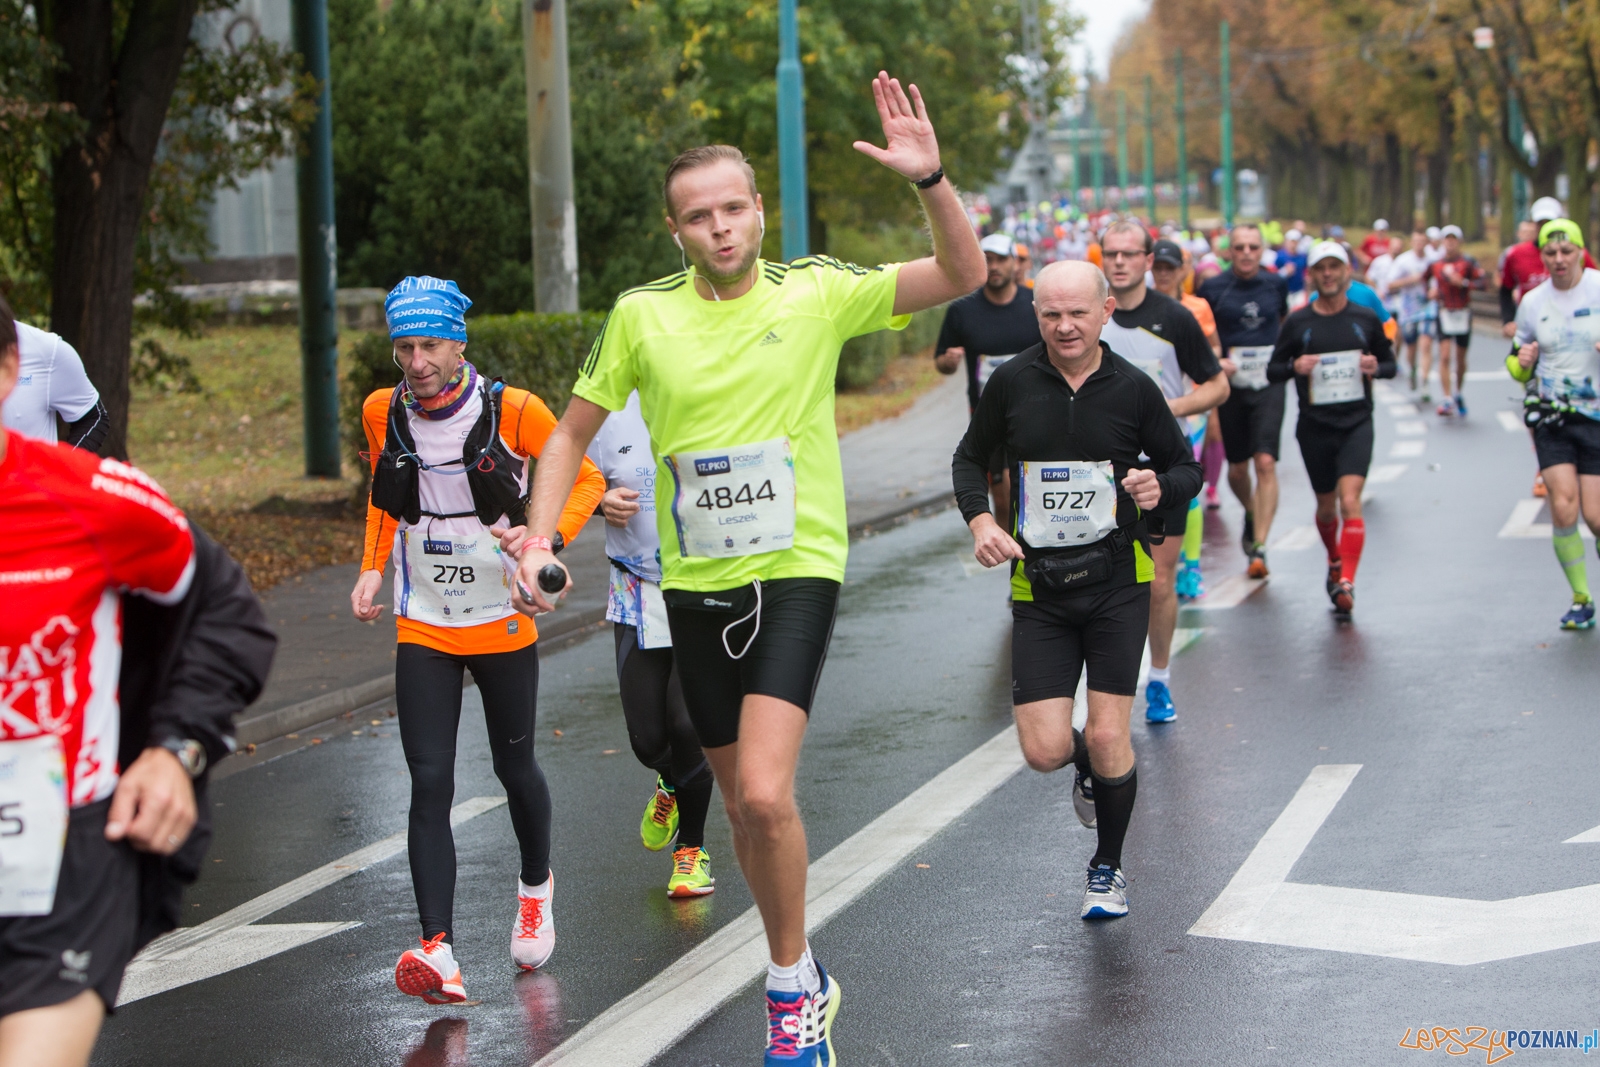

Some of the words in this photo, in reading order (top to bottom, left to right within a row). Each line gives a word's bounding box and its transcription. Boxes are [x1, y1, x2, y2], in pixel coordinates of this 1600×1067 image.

[416, 278, 447, 291] RUN
[393, 308, 443, 319] BROOKS
[696, 479, 776, 510] 4844
[1043, 491, 1096, 509] 6727
[718, 512, 759, 526] Leszek
[1050, 514, 1090, 523] Zbigniew
[433, 564, 475, 584] 278
[444, 588, 466, 597] Artur
